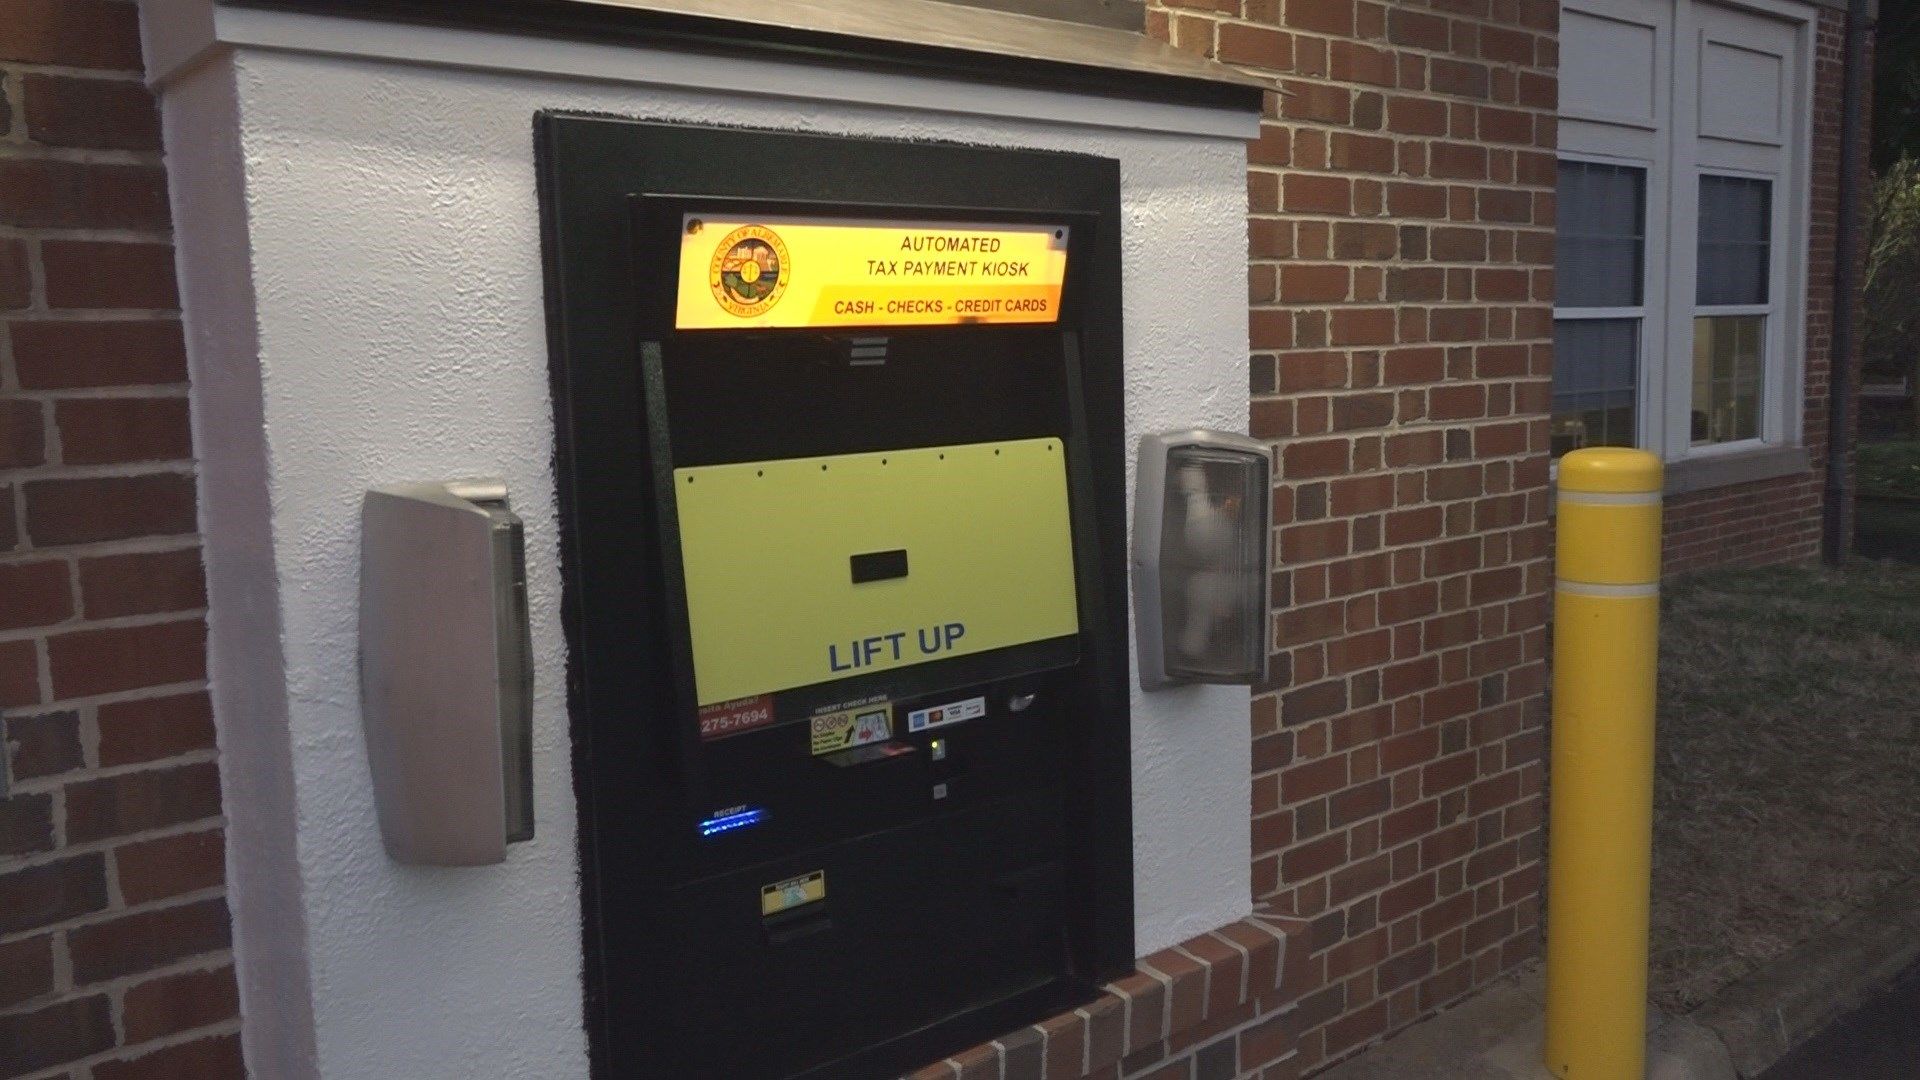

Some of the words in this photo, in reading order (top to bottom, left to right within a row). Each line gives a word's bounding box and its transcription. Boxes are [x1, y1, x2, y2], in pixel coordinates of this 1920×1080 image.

[901, 236, 1001, 253] AUTOMATED
[867, 260, 898, 276] TAX
[903, 261, 978, 277] PAYMENT
[982, 262, 1029, 277] KIOSK
[834, 300, 874, 314] CASH
[887, 299, 943, 313] CHECKS
[955, 299, 1001, 313] CREDIT
[1005, 298, 1047, 312] CARDS
[829, 632, 906, 672] LIFT
[918, 622, 965, 655] UP
[701, 707, 768, 733] 275-7694
[714, 804, 747, 818] RECEIPT
